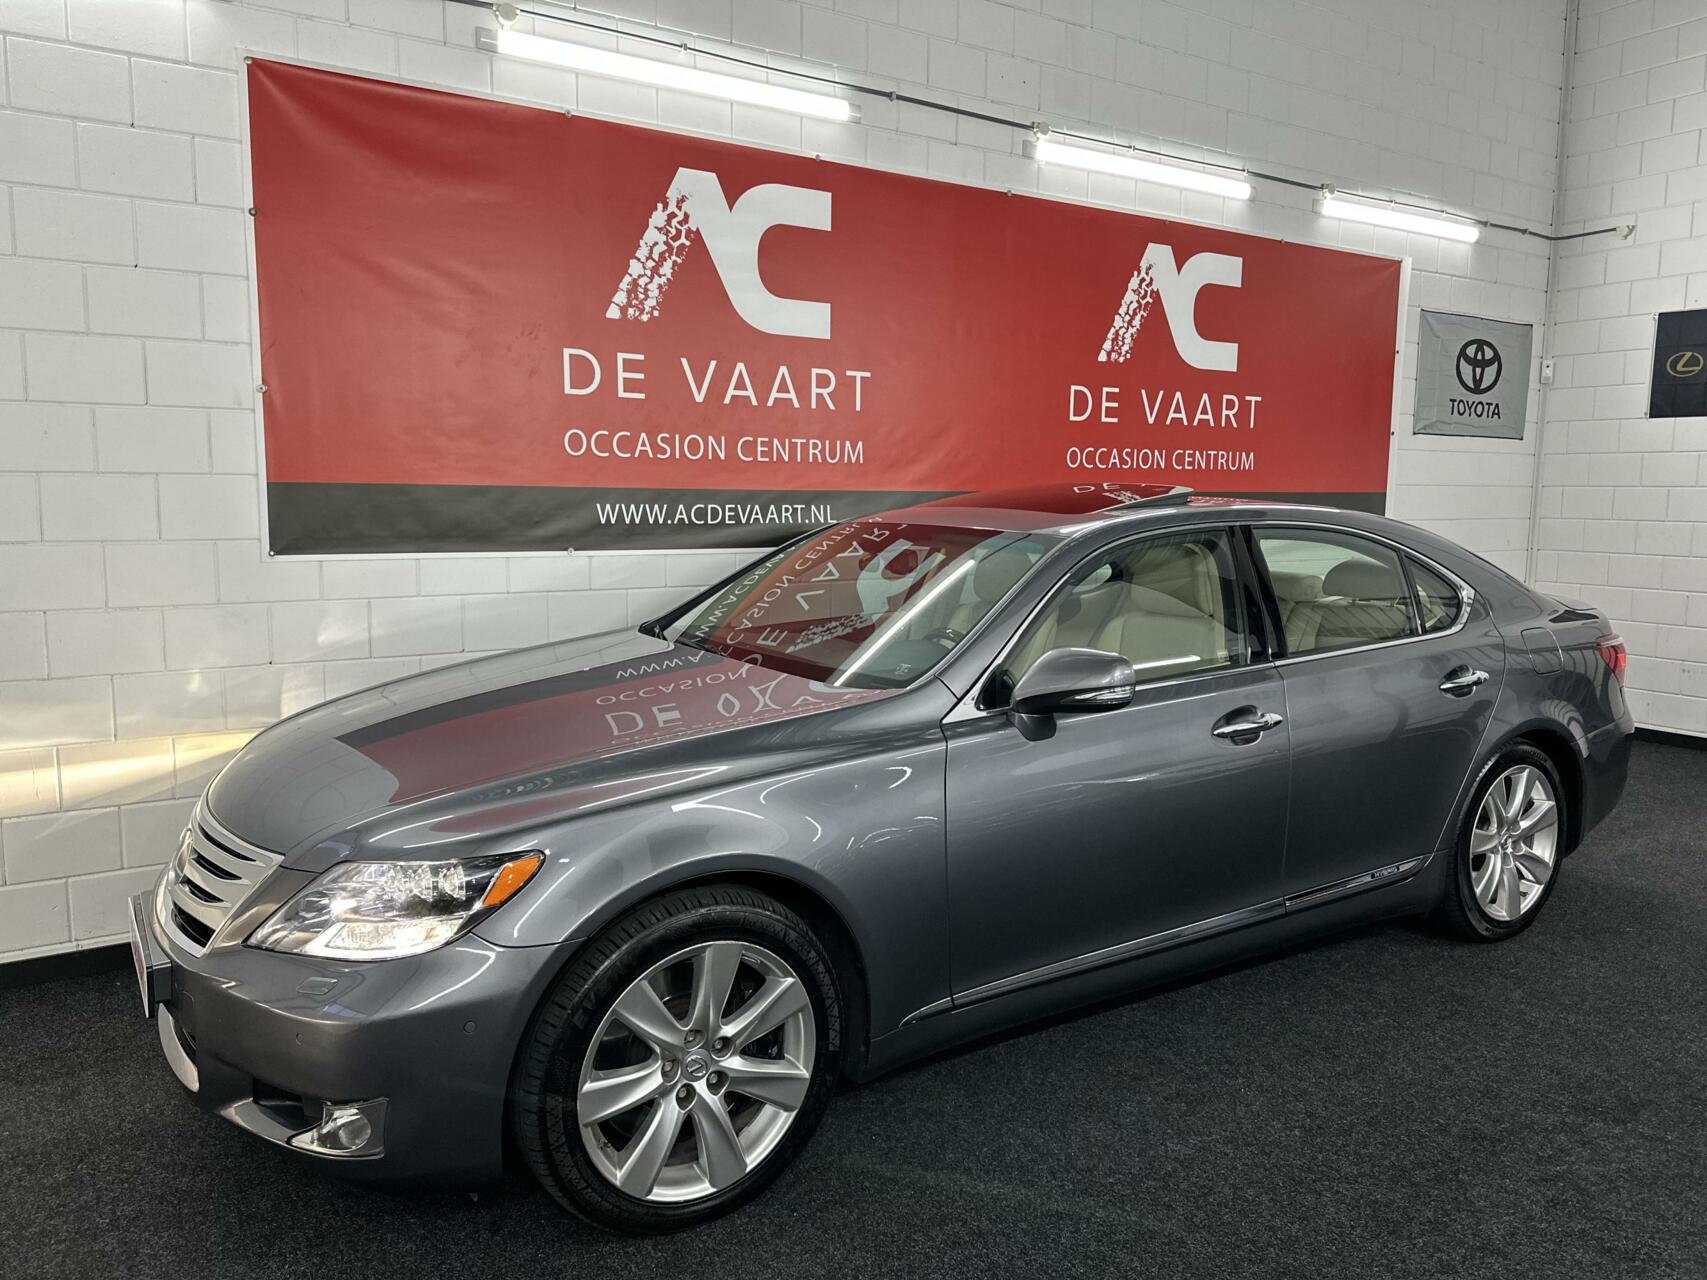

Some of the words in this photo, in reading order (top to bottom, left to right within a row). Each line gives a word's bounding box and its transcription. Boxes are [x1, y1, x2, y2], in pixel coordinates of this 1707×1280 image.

[562, 347, 646, 400] DE
[680, 357, 872, 412] VAART
[1068, 384, 1120, 423] DE
[1141, 389, 1263, 429] VAART
[1449, 398, 1501, 420] TOYOTA
[563, 429, 726, 461] OCCASION
[736, 436, 865, 464] CENTRUM
[1066, 446, 1166, 470] OCCASION
[1172, 449, 1255, 471] CENTRUM
[596, 502, 838, 526] WWW.ACDEVAART.NL
